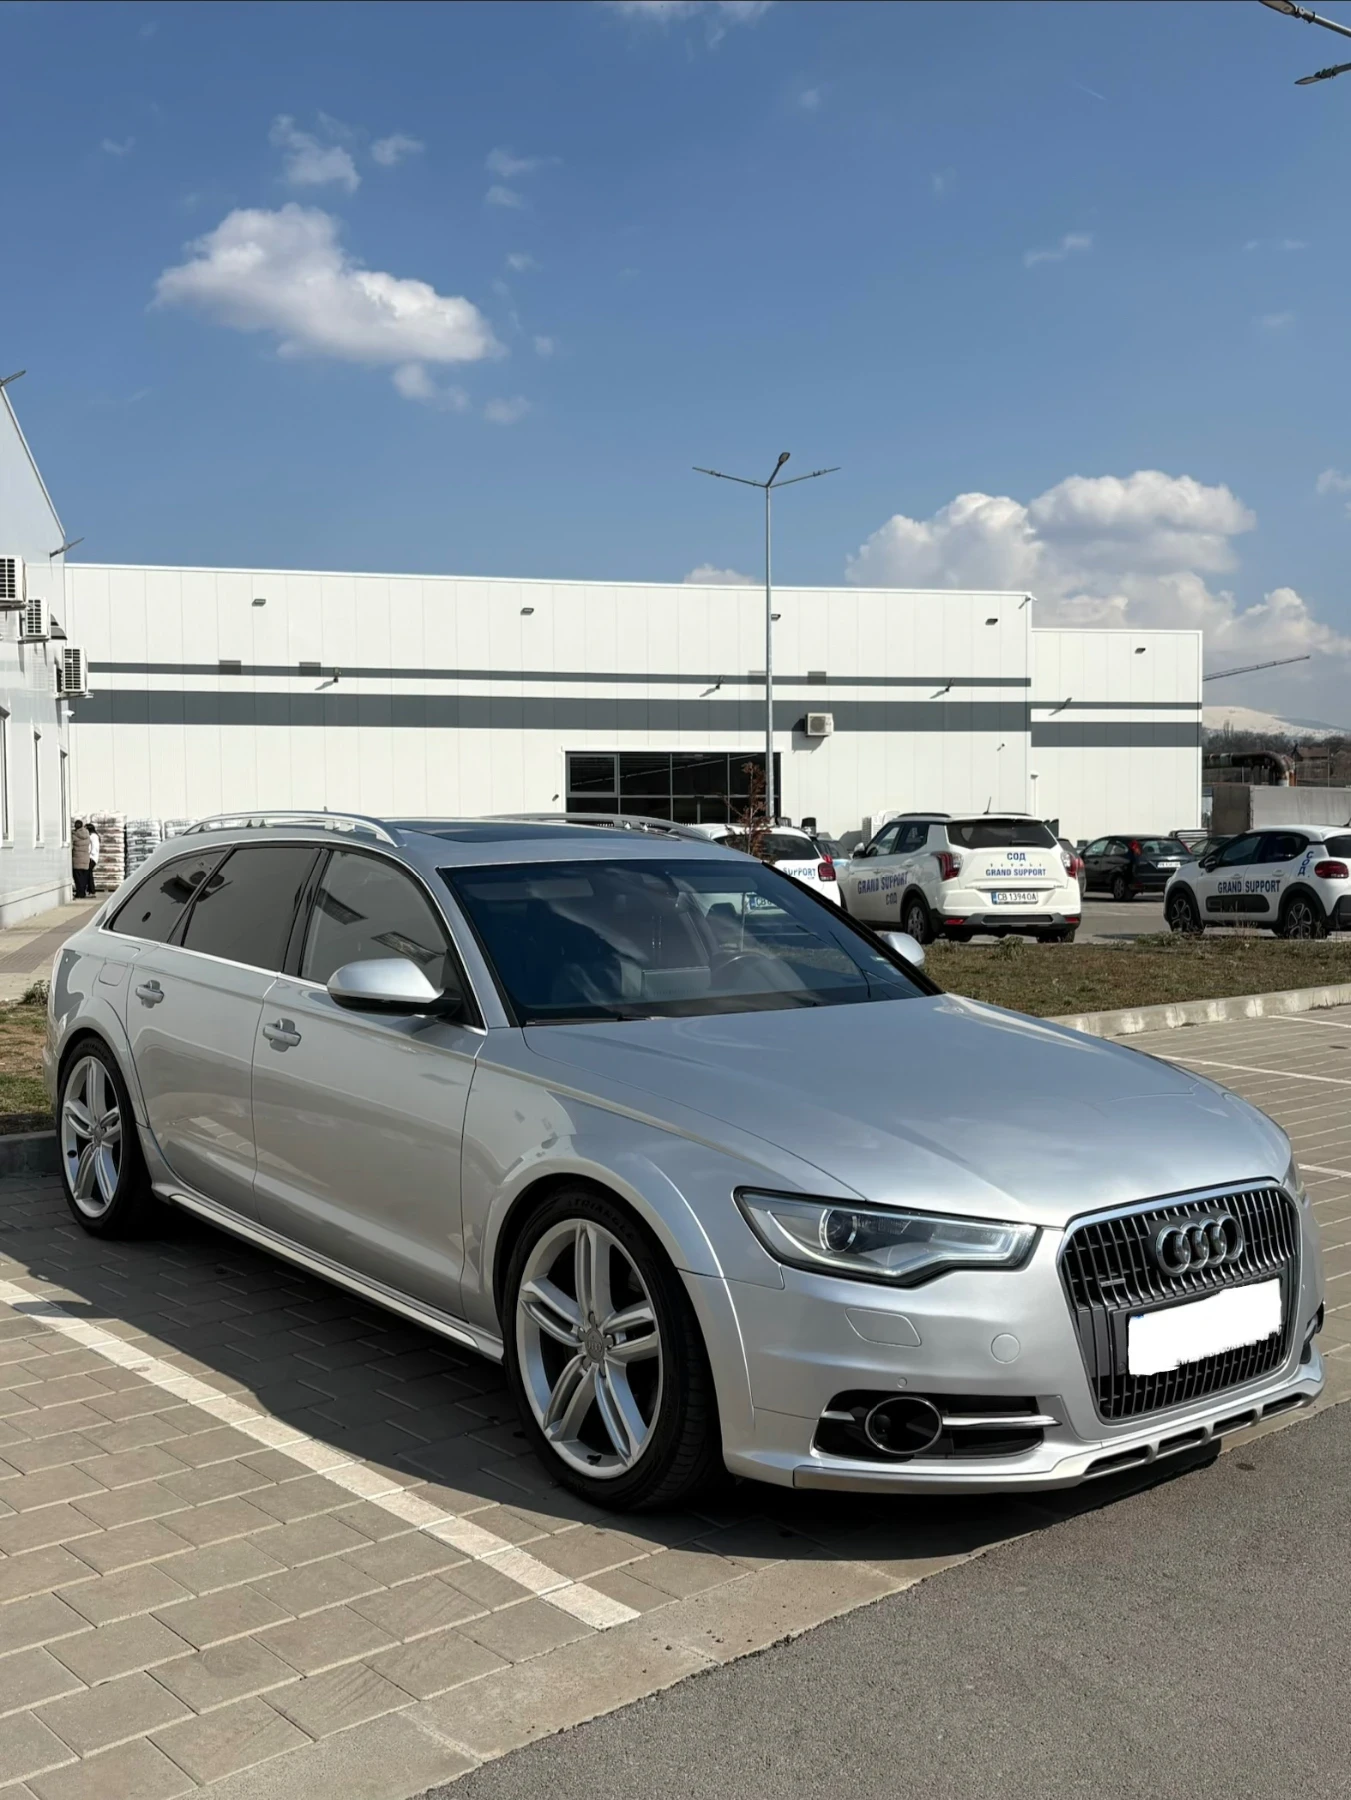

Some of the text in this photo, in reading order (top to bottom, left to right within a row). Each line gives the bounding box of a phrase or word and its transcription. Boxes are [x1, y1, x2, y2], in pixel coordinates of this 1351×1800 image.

[1006, 852, 1026, 861] СОД
[985, 868, 1046, 876] GRAND SUPPORT
[858, 871, 908, 894] GRAND SUPPORT
[1218, 880, 1281, 894] GRAND SUPPORT
